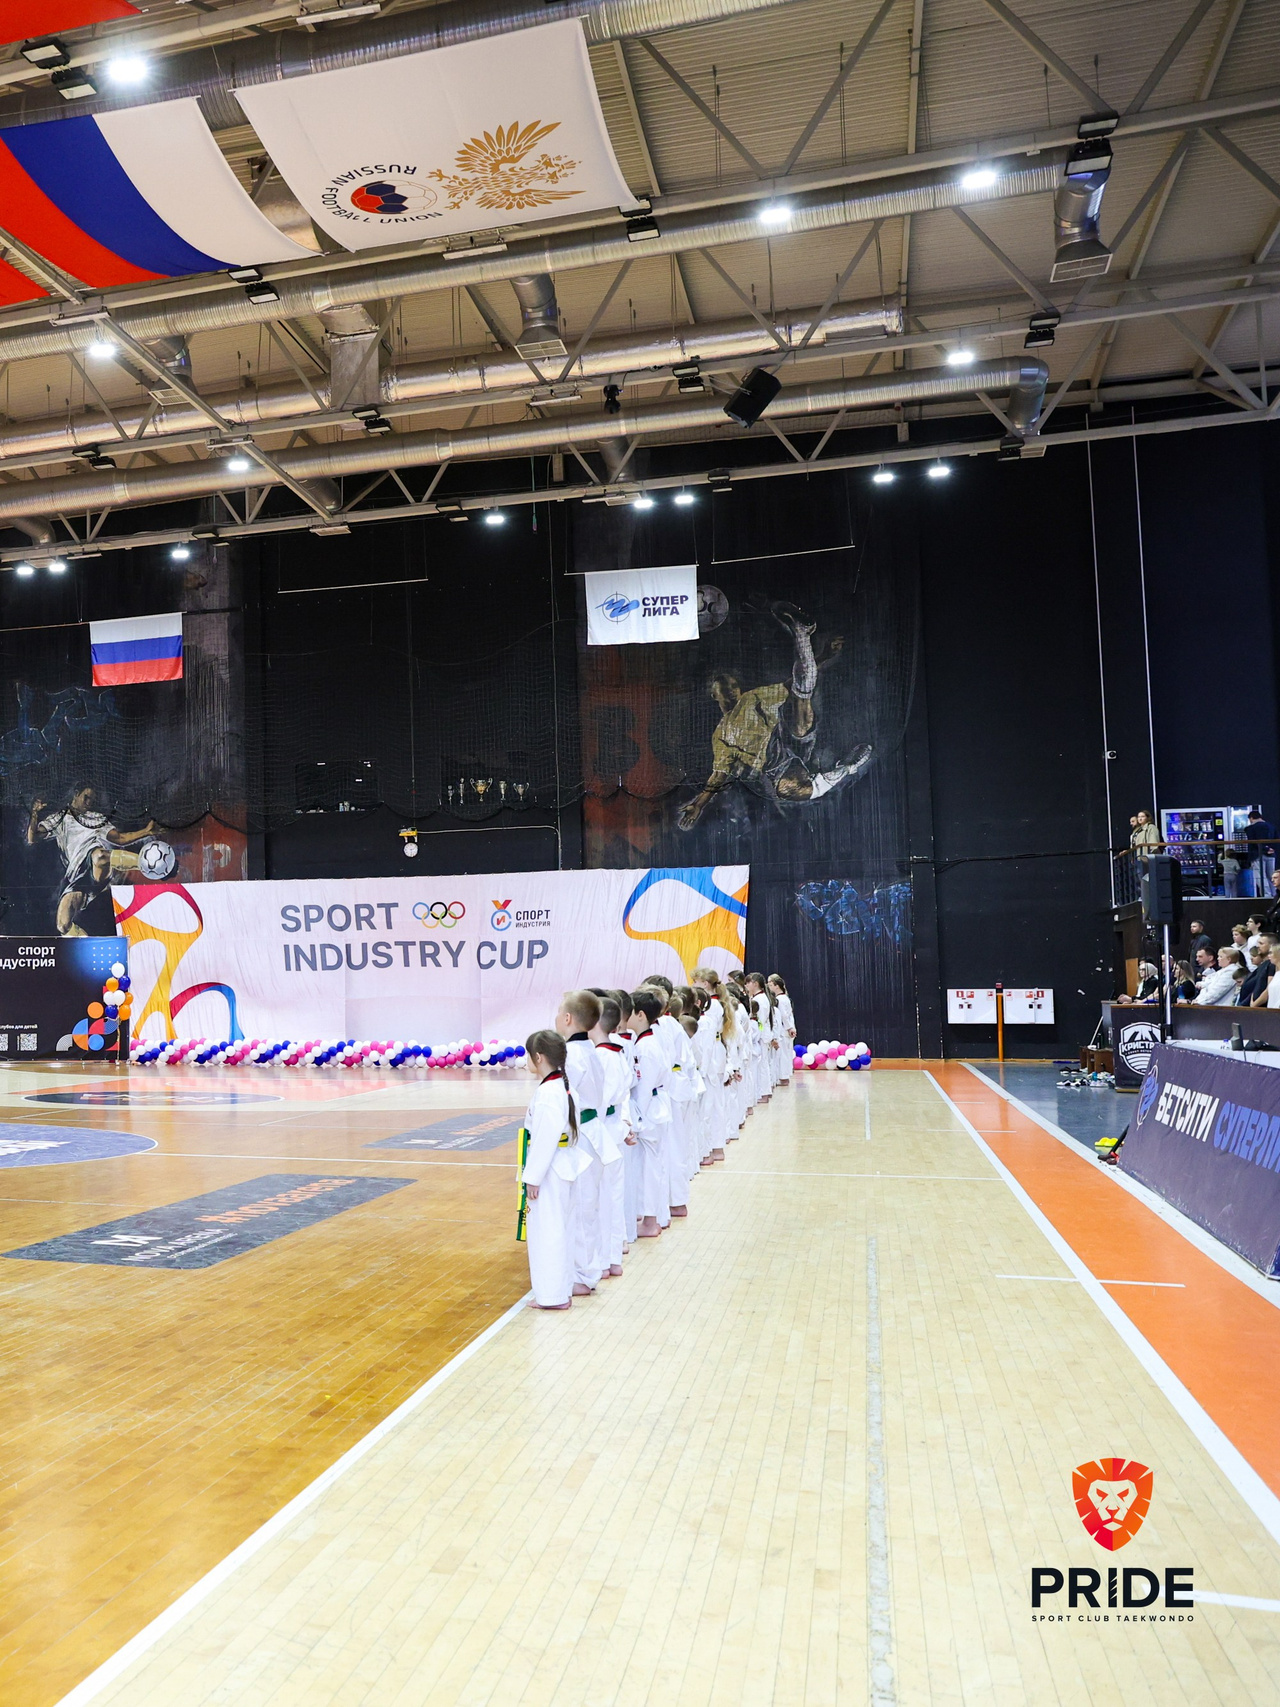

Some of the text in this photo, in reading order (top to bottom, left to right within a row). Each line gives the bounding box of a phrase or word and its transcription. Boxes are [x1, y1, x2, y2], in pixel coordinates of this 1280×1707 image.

[321, 164, 444, 224] RUSSIAN FOOTBALL UNION
[641, 595, 689, 606] СУПЕР
[642, 606, 680, 617] ЛИГА
[280, 902, 399, 933] SPORT
[515, 910, 551, 921] СПОРТ
[18, 947, 56, 957] спорт
[283, 940, 550, 972] INDUSTRY CUP
[1155, 1082, 1219, 1142] БЕТСИТИ
[194, 1179, 357, 1223] #novaarena
[121, 1246, 183, 1262] NOVA
[168, 1228, 230, 1247] ARENA
